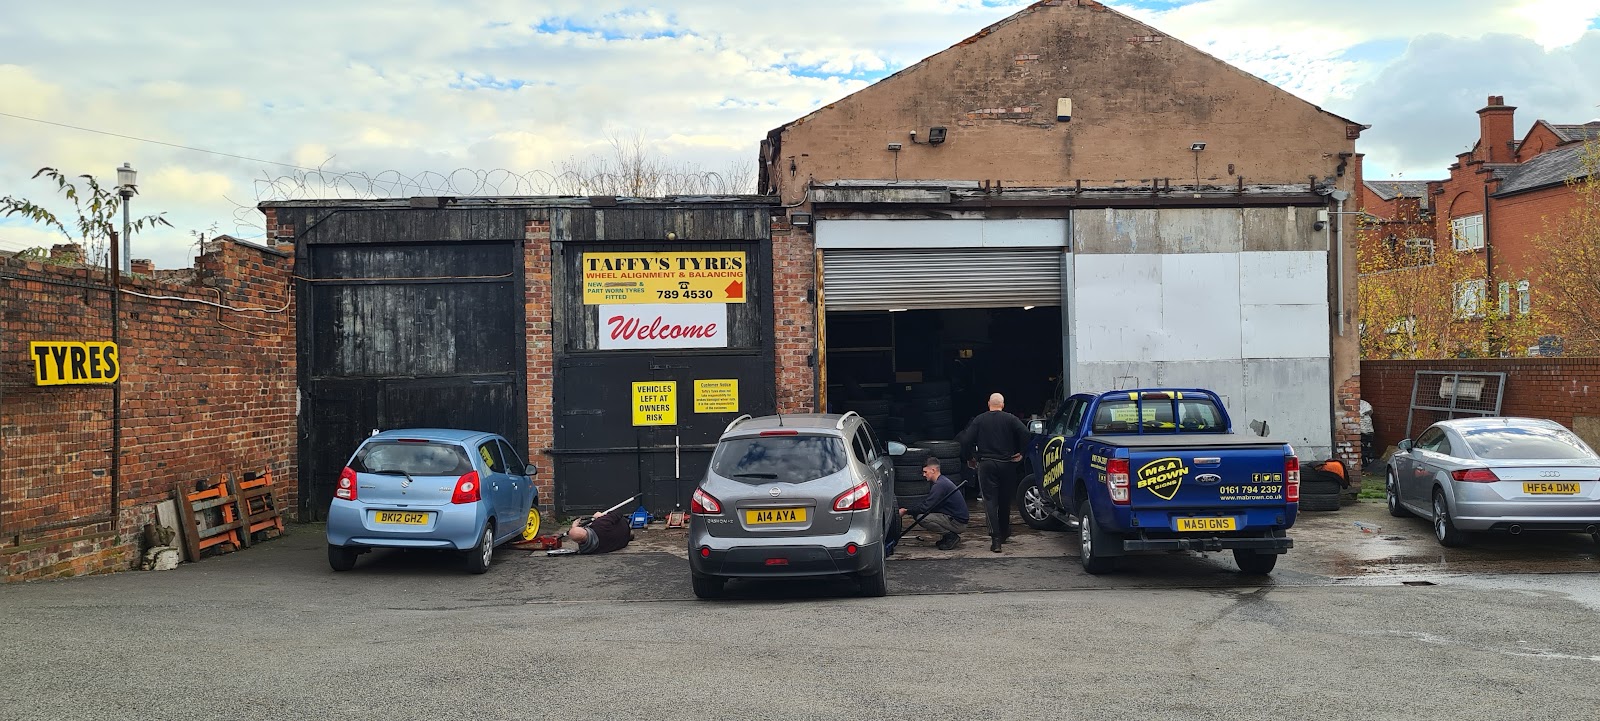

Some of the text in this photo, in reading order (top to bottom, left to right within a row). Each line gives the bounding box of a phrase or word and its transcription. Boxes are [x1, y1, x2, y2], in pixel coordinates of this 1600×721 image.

[586, 256, 743, 271] TAFFY'S TYRES
[620, 271, 676, 279] ALIGNMENT
[656, 290, 713, 299] 789 4530
[607, 315, 718, 341] Welcome
[34, 345, 116, 381] TYRES
[637, 385, 672, 393] VEHICLES
[640, 394, 668, 403] LEFT AT
[639, 404, 670, 412] OWNERS
[1137, 466, 1189, 489] BROWN
[1154, 480, 1177, 490] SIGNS
[1220, 485, 1282, 494] 0161 794 2397
[1527, 483, 1576, 492] HF64 DMX
[381, 512, 424, 523] BK12 GHZ
[756, 510, 796, 522] A14 AYA
[1183, 518, 1230, 529] MA51 GNS
